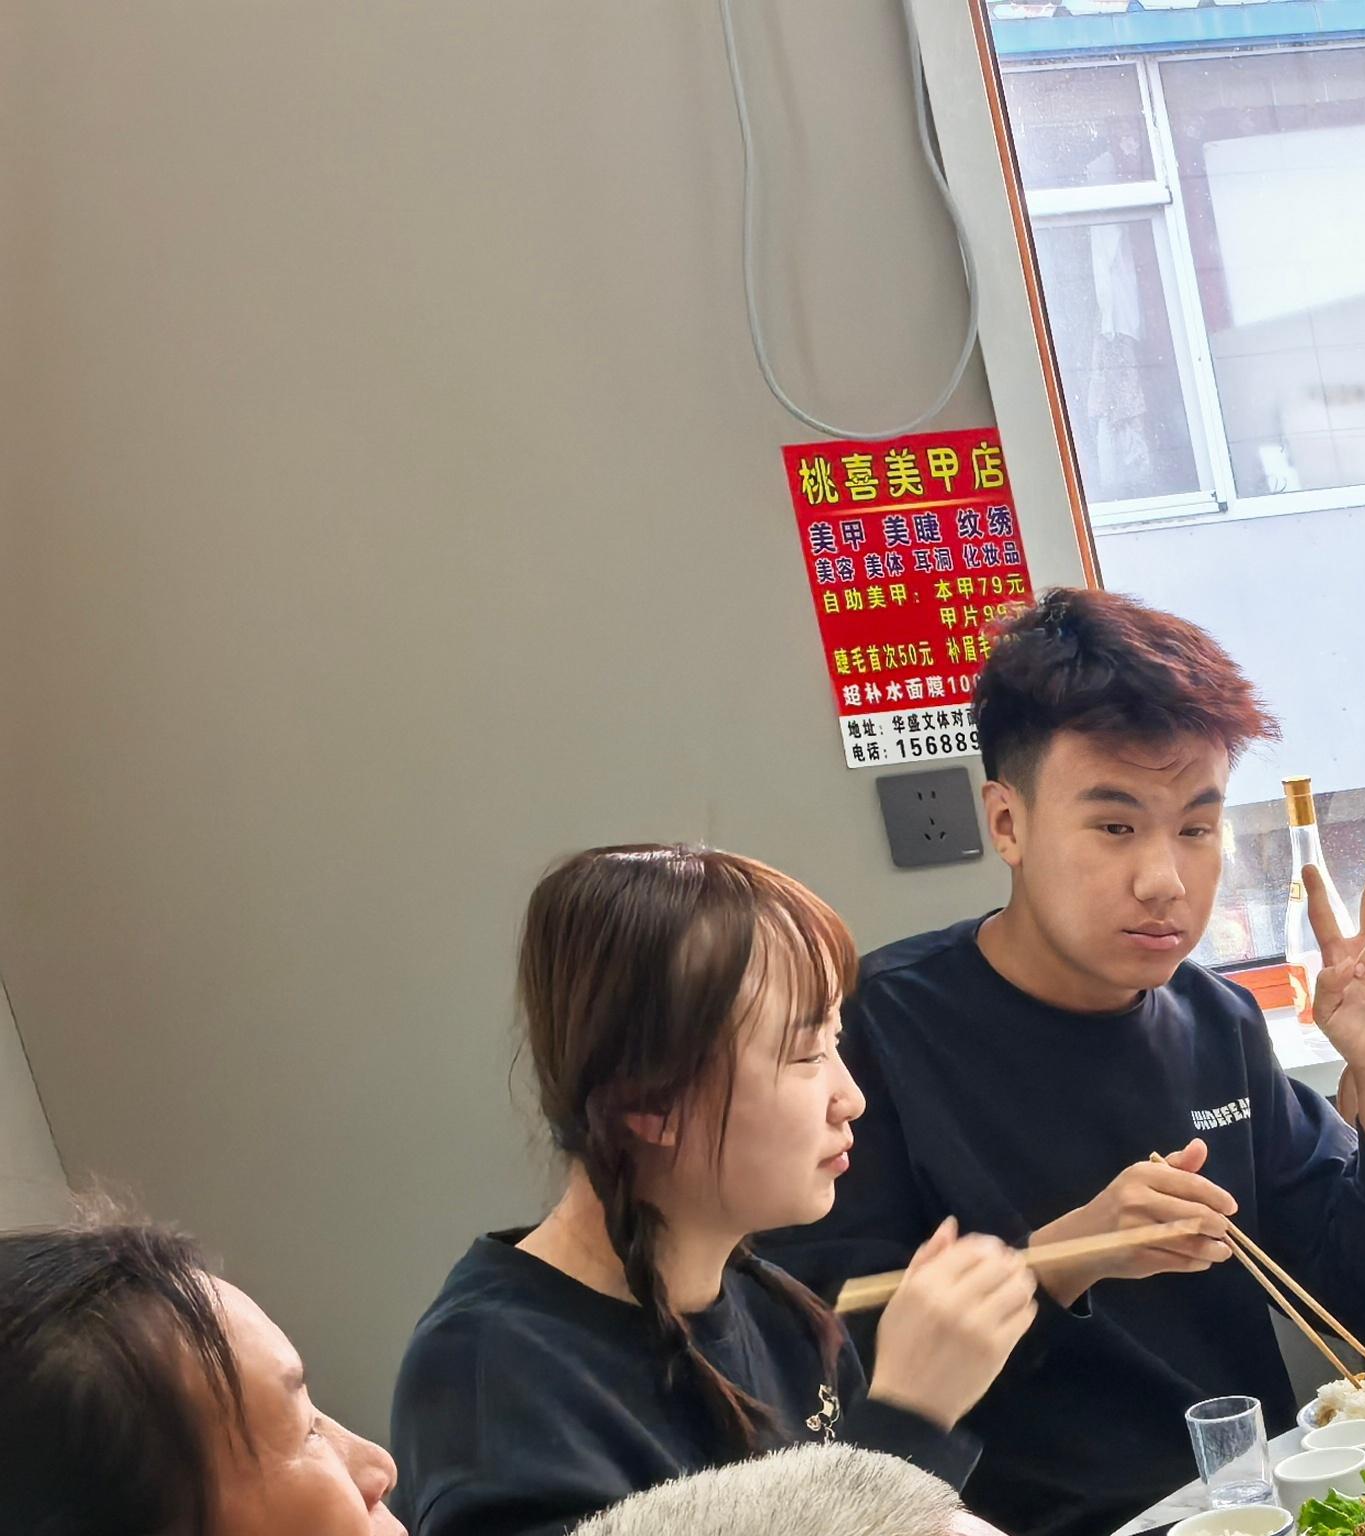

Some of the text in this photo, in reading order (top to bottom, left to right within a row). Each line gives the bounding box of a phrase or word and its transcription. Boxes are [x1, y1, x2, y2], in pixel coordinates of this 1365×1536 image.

[798, 441, 1004, 505] 桃喜美甲店
[809, 504, 1014, 555] 美甲 美睫 纹绣
[815, 542, 1022, 584] 美容 美体 耳洞 化妆品
[823, 573, 1025, 614] 自助美甲： 本甲79元
[834, 640, 934, 675] 睫毛首次50元
